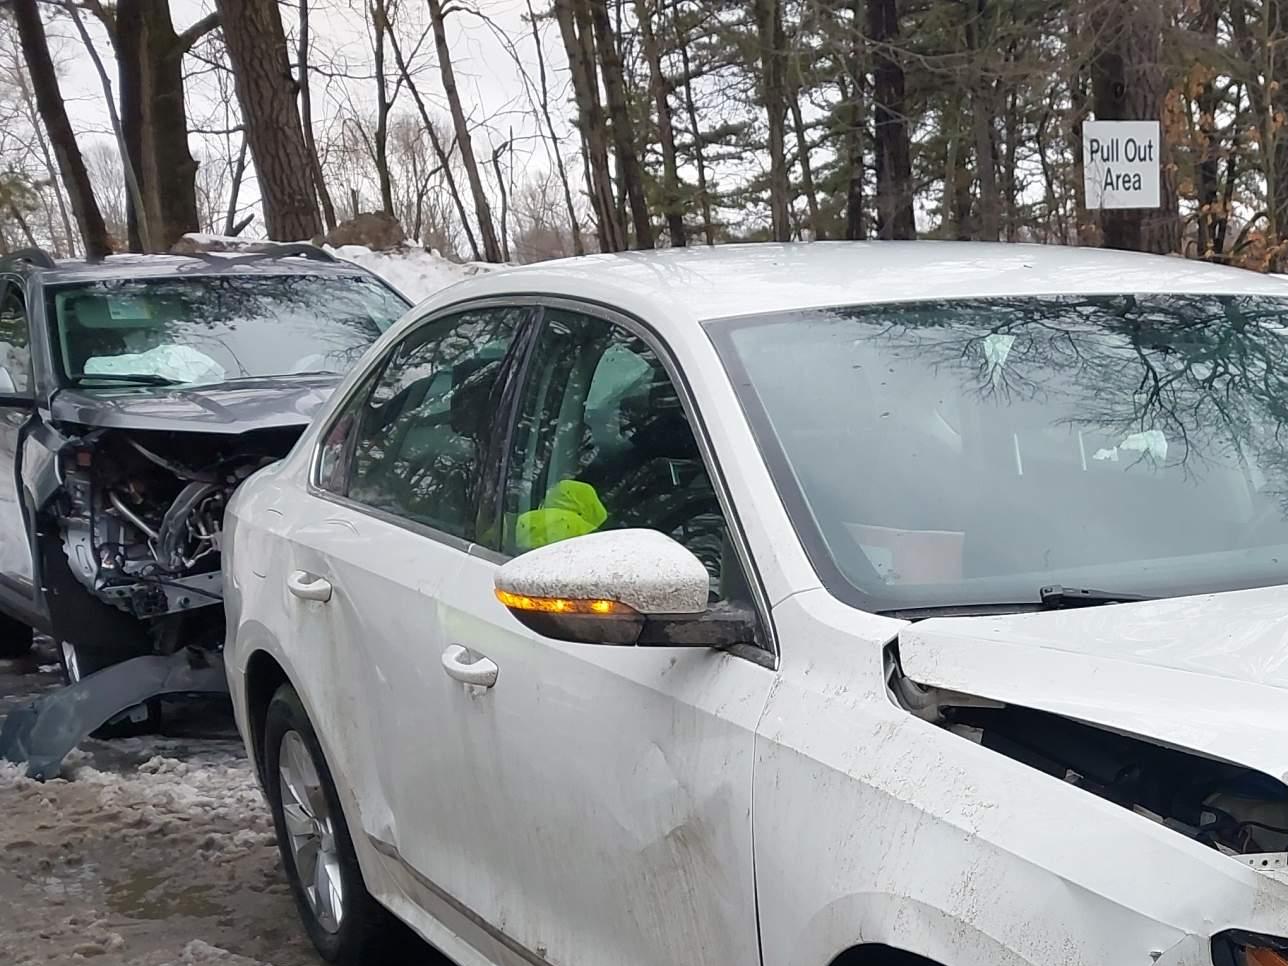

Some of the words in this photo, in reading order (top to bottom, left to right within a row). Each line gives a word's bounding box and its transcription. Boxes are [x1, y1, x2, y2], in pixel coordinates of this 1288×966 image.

[1089, 137, 1119, 163] Pull
[1124, 137, 1154, 163] Out
[1103, 166, 1142, 191] Area
